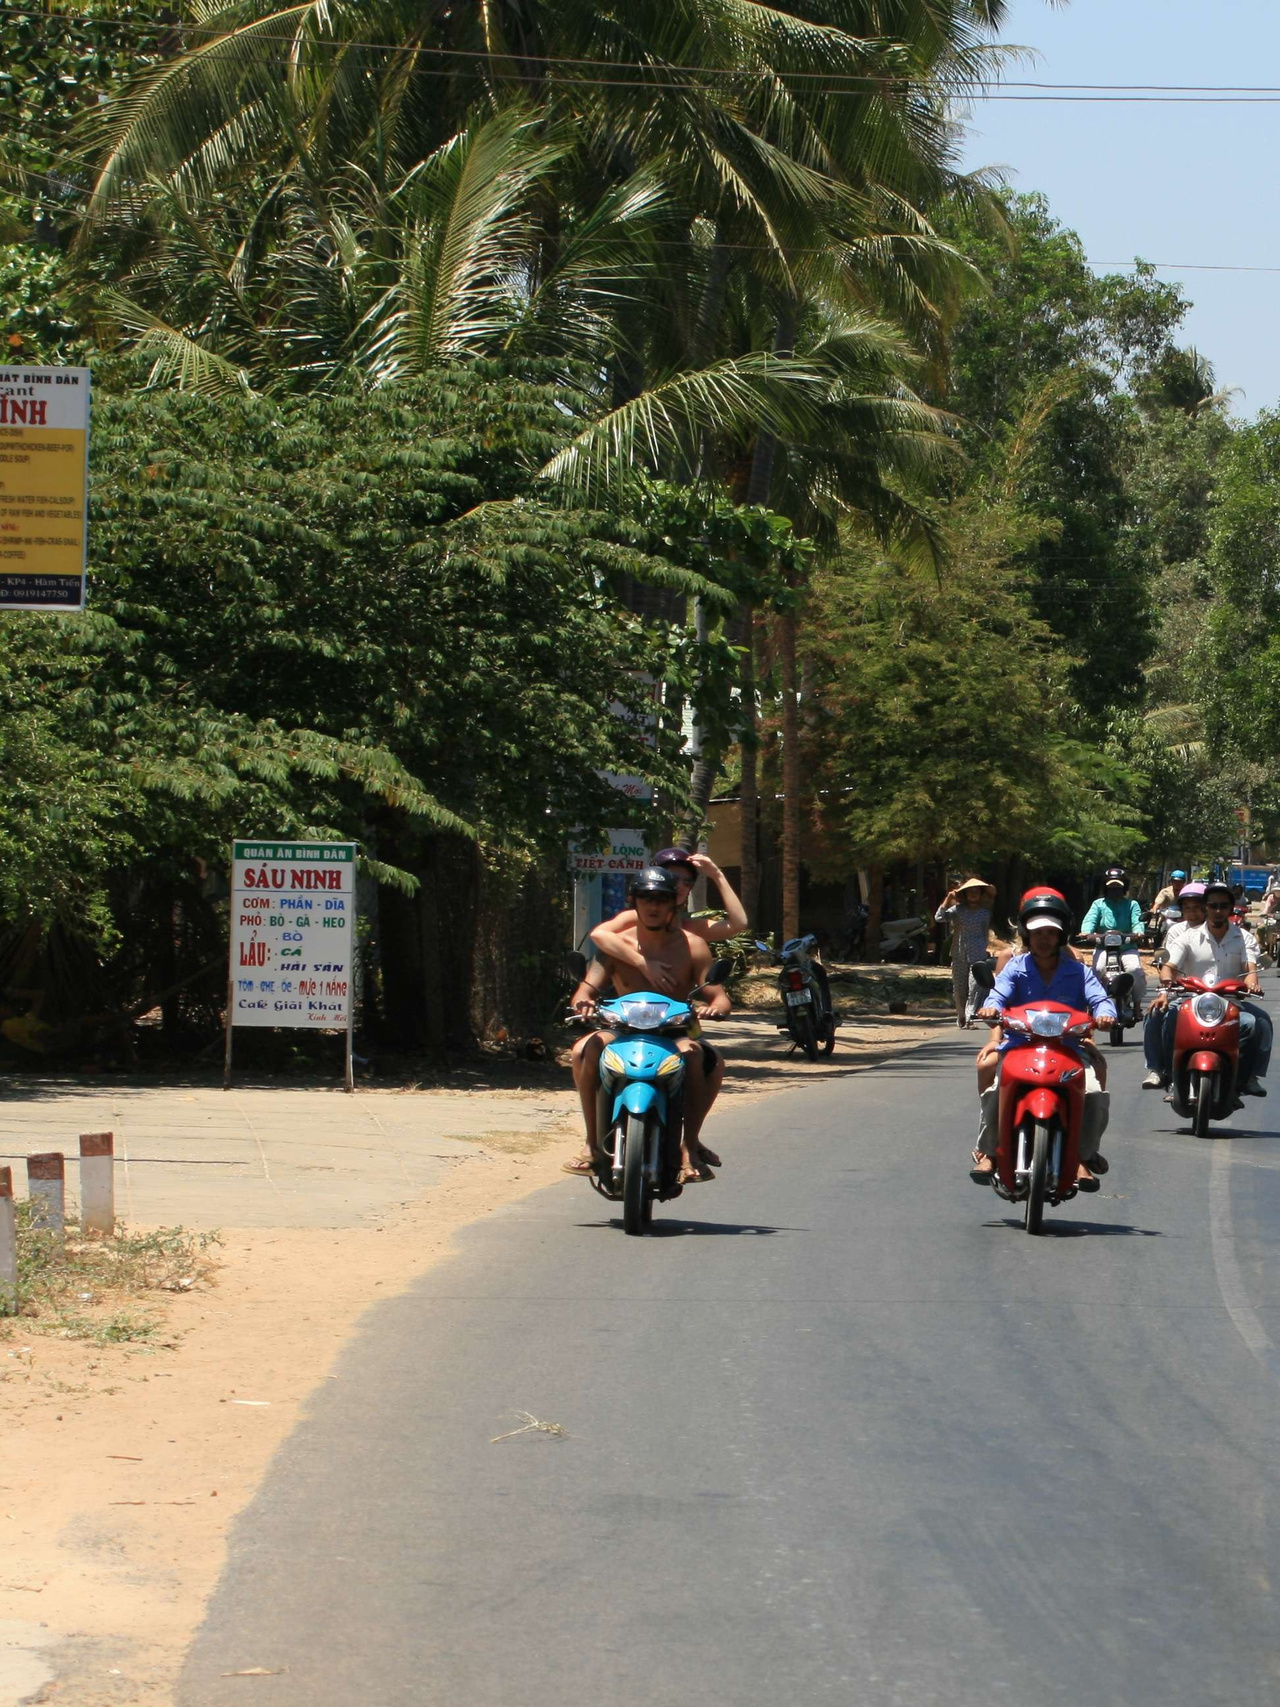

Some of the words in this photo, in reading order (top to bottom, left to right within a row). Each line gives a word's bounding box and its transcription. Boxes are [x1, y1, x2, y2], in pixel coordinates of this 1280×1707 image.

[56, 374, 79, 385] DÂN
[13, 590, 68, 598] 0919147750
[244, 847, 273, 858] QUÁN
[296, 849, 320, 860] BÌNH
[323, 849, 346, 860] DÂN
[244, 862, 286, 889] SÁU
[290, 869, 342, 890] NINH
[270, 912, 284, 927] BÒ
[296, 913, 310, 927] GÀ
[323, 917, 345, 928] HEO
[281, 946, 303, 957] CÁ
